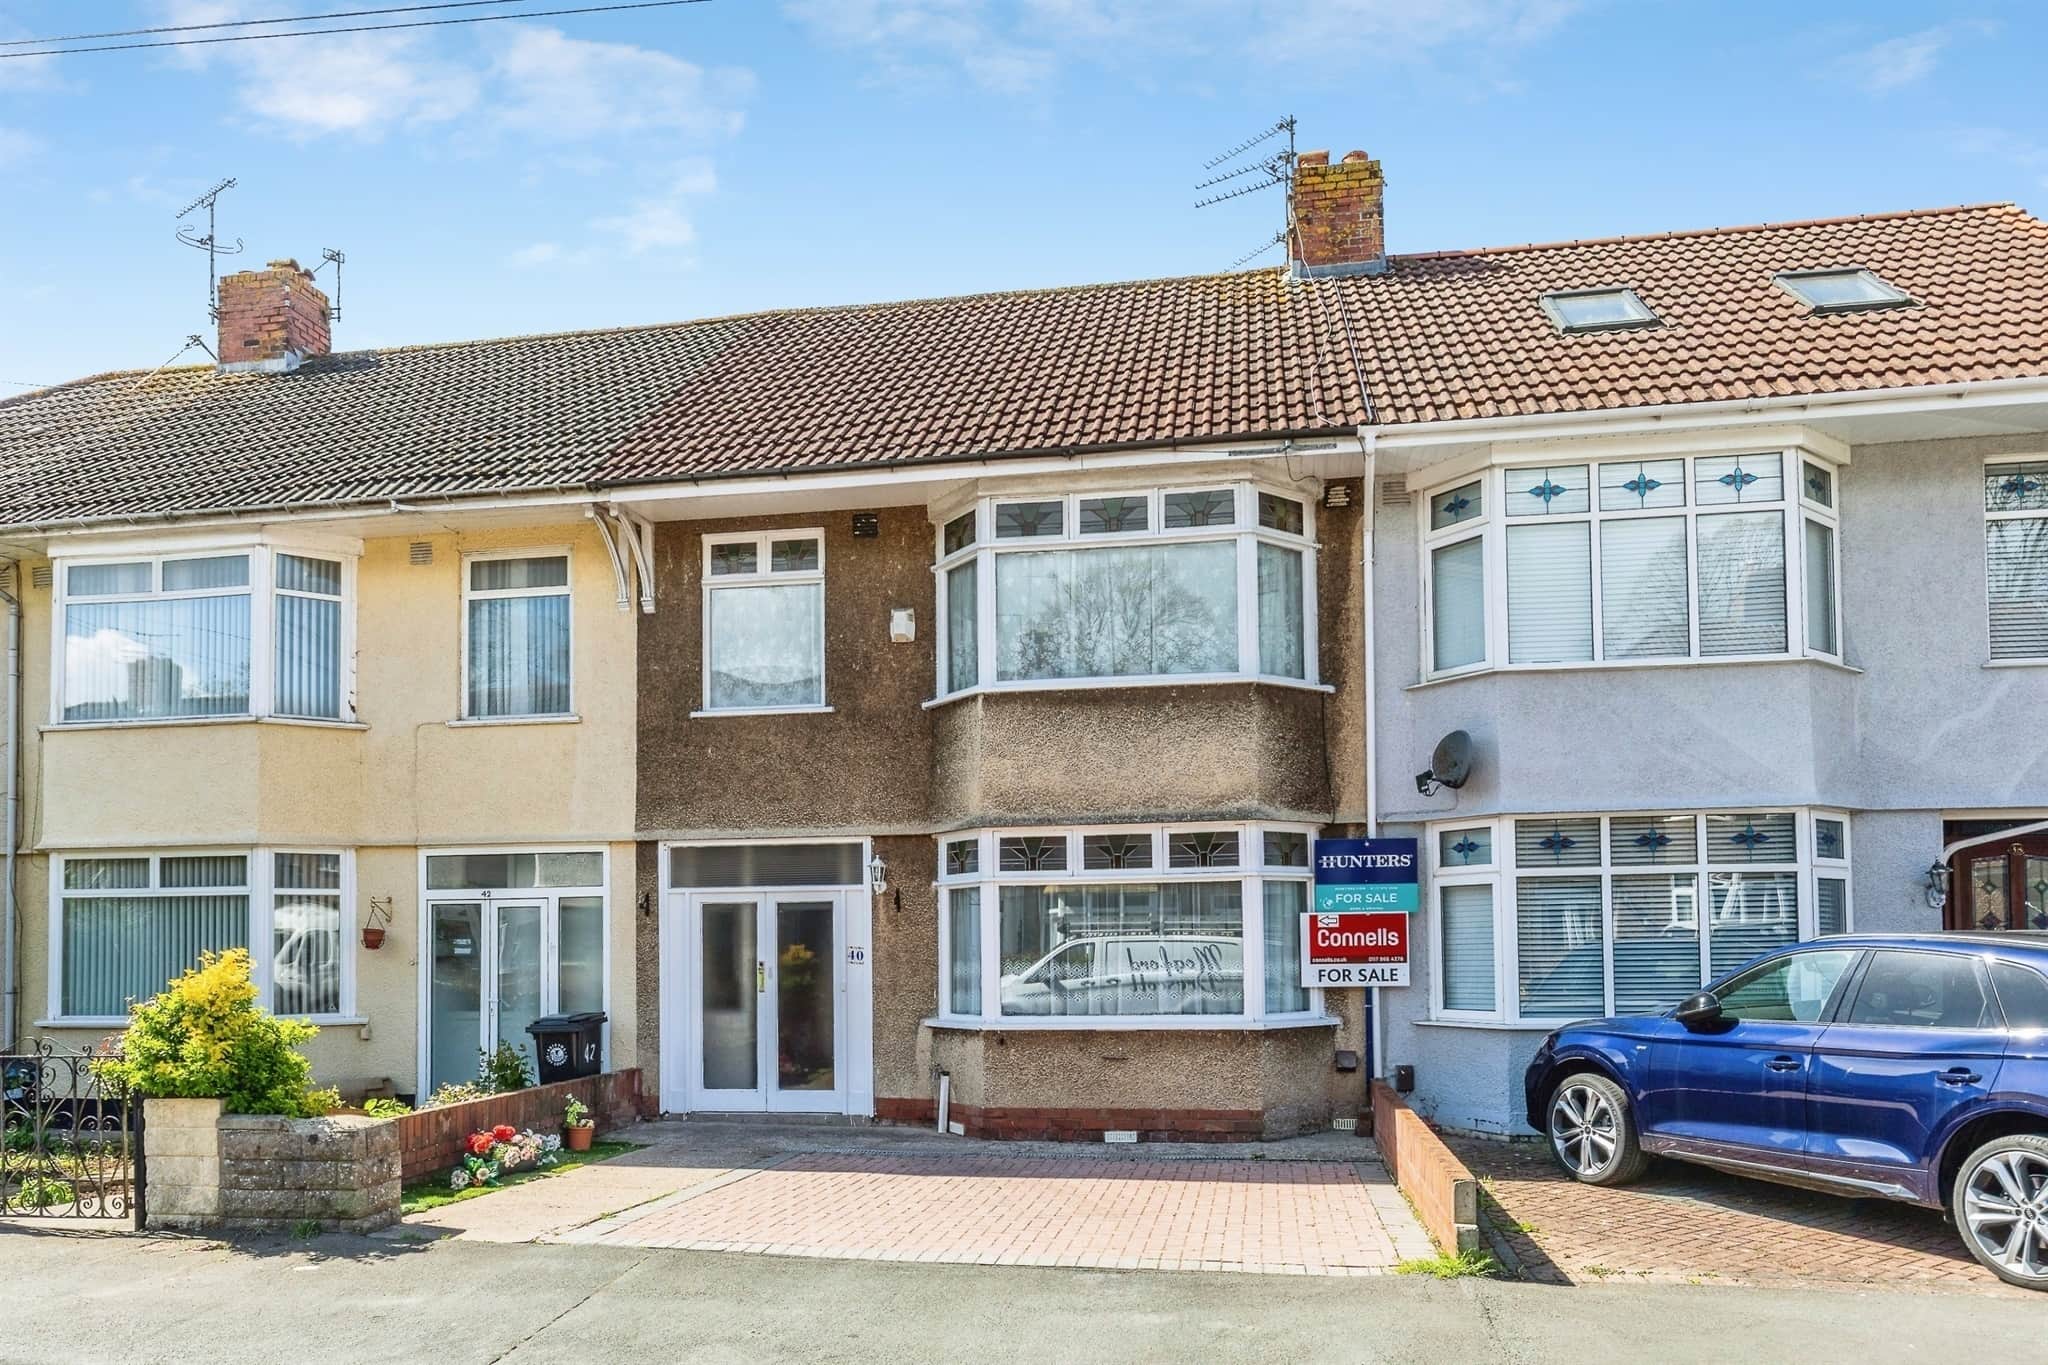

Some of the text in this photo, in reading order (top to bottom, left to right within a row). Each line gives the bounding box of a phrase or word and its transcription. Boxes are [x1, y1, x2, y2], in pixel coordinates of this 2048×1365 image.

[1318, 854, 1411, 869] HUNTERS
[481, 890, 491, 898] 42
[1335, 893, 1398, 904] FOR SALE
[1317, 928, 1400, 947] Connells
[848, 950, 864, 961] 40
[1318, 968, 1399, 982] FOR SALE
[584, 1042, 596, 1063] 42
